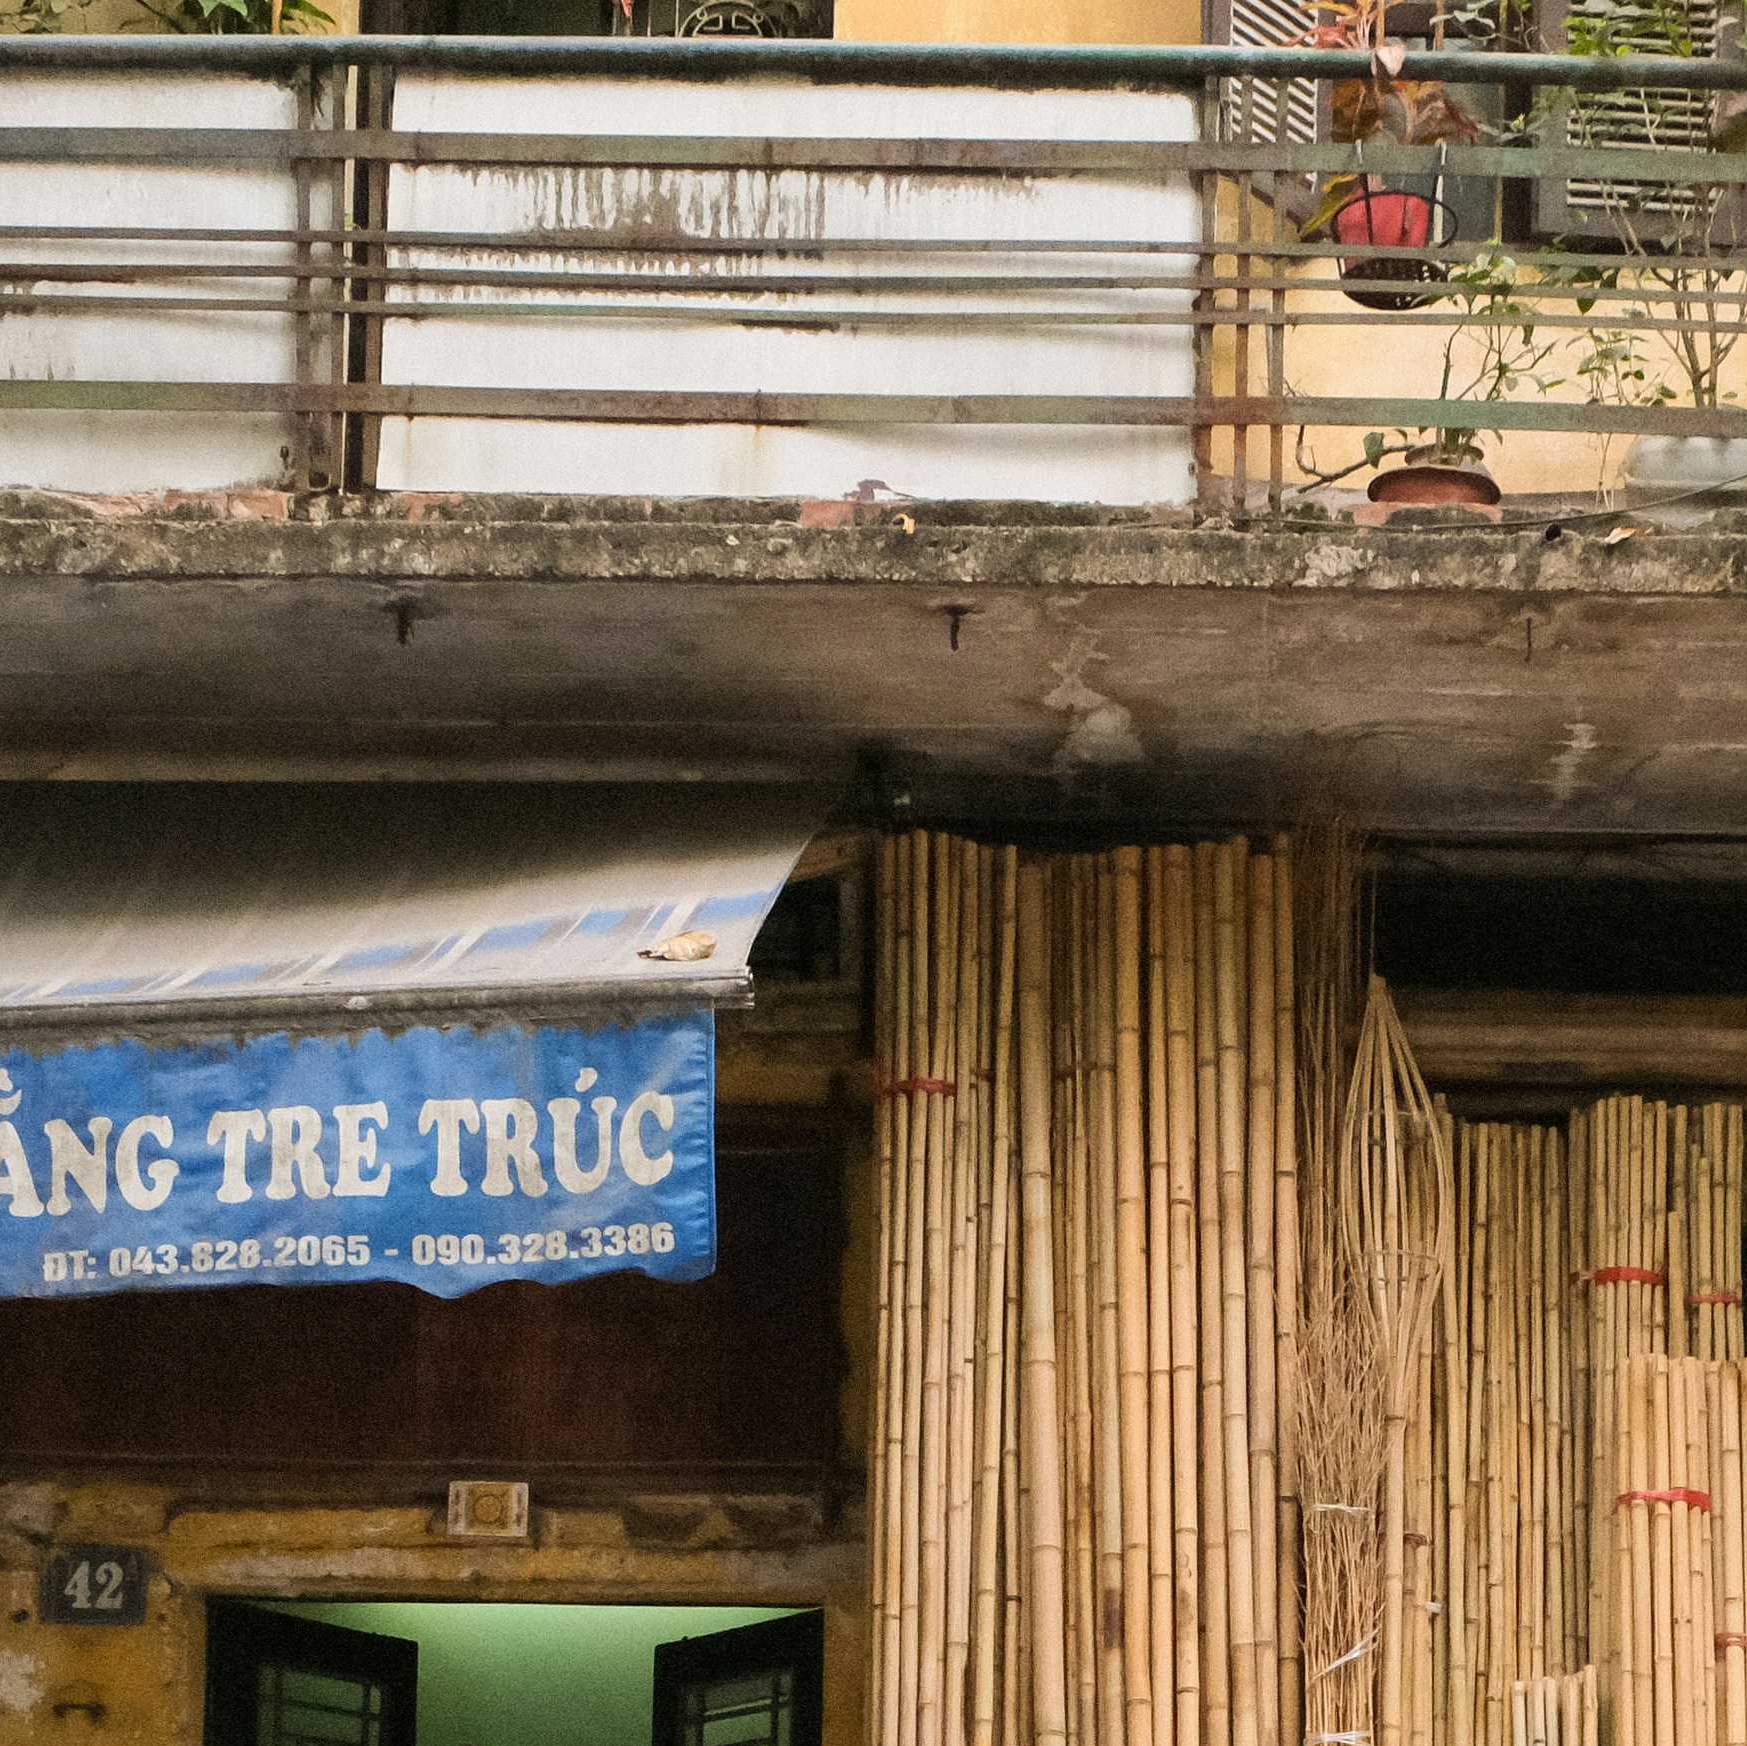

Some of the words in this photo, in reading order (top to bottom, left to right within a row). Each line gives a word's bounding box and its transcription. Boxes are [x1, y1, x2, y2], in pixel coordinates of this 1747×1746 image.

[207, 1101, 392, 1203] TRE
[419, 1067, 674, 1197] TRÚC
[42, 1249, 97, 1282] ĐT:
[109, 1235, 370, 1277] 043.828.2065
[411, 1222, 675, 1266] 090.328.3386
[64, 1560, 123, 1610] 42
